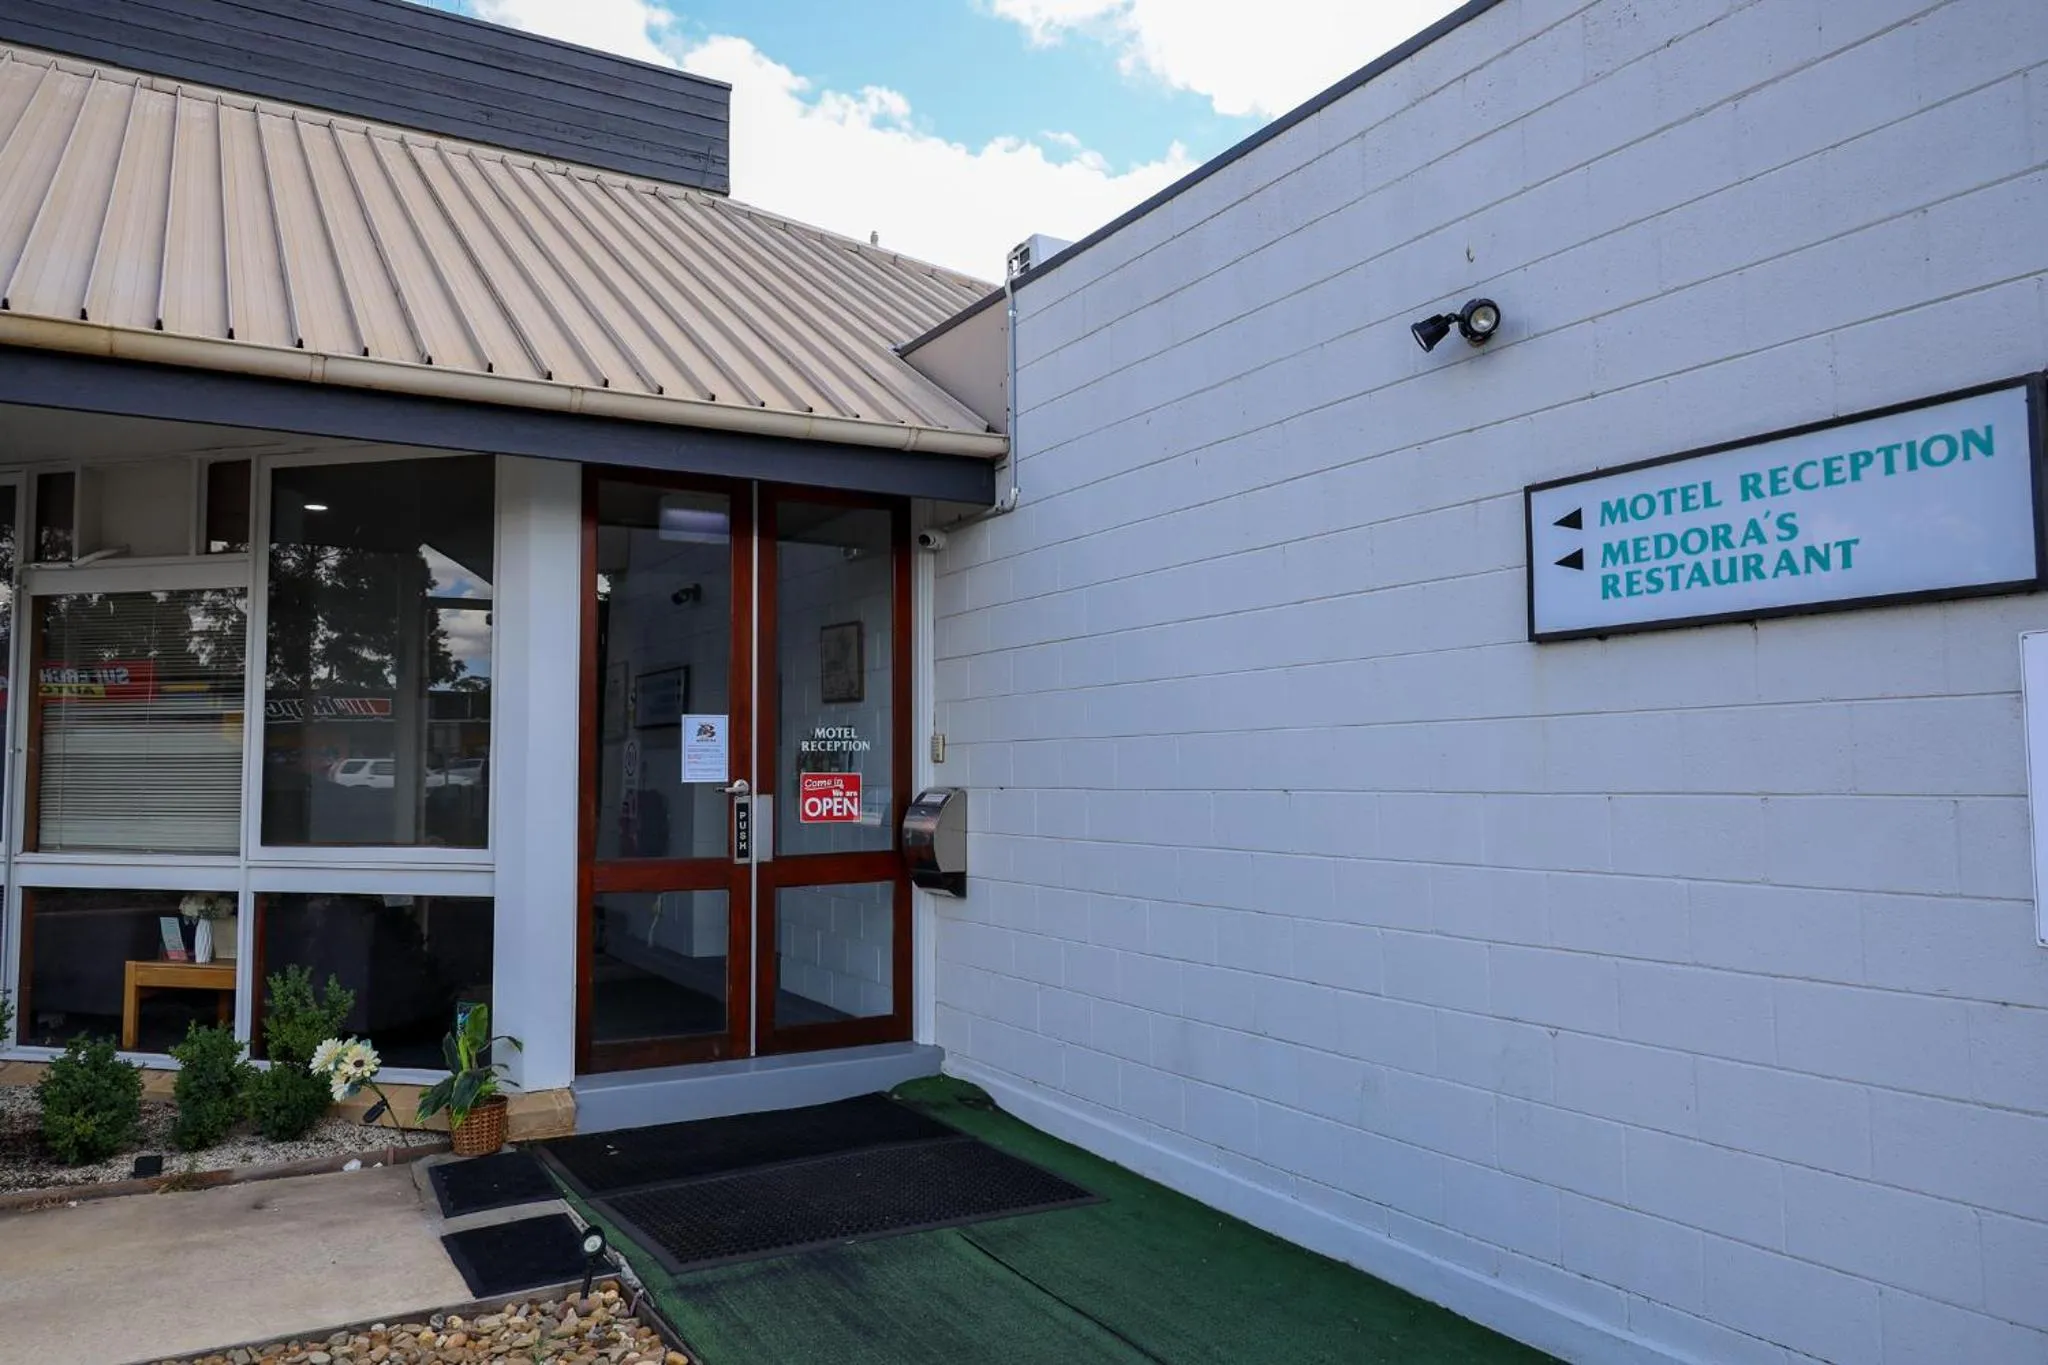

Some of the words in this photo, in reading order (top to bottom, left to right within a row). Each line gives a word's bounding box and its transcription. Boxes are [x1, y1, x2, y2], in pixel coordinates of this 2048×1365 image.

[1600, 480, 1722, 527] MOTEL
[1739, 424, 1995, 502] RECEPTION
[1601, 510, 1799, 568] MEDORA'S
[1601, 538, 1860, 600] RESTAURANT
[814, 727, 858, 739] MOTEL
[801, 740, 871, 752] RECEPTION
[804, 778, 833, 788] Come
[832, 789, 844, 797] We
[804, 797, 858, 817] OPEN
[739, 811, 747, 850] PUSH
